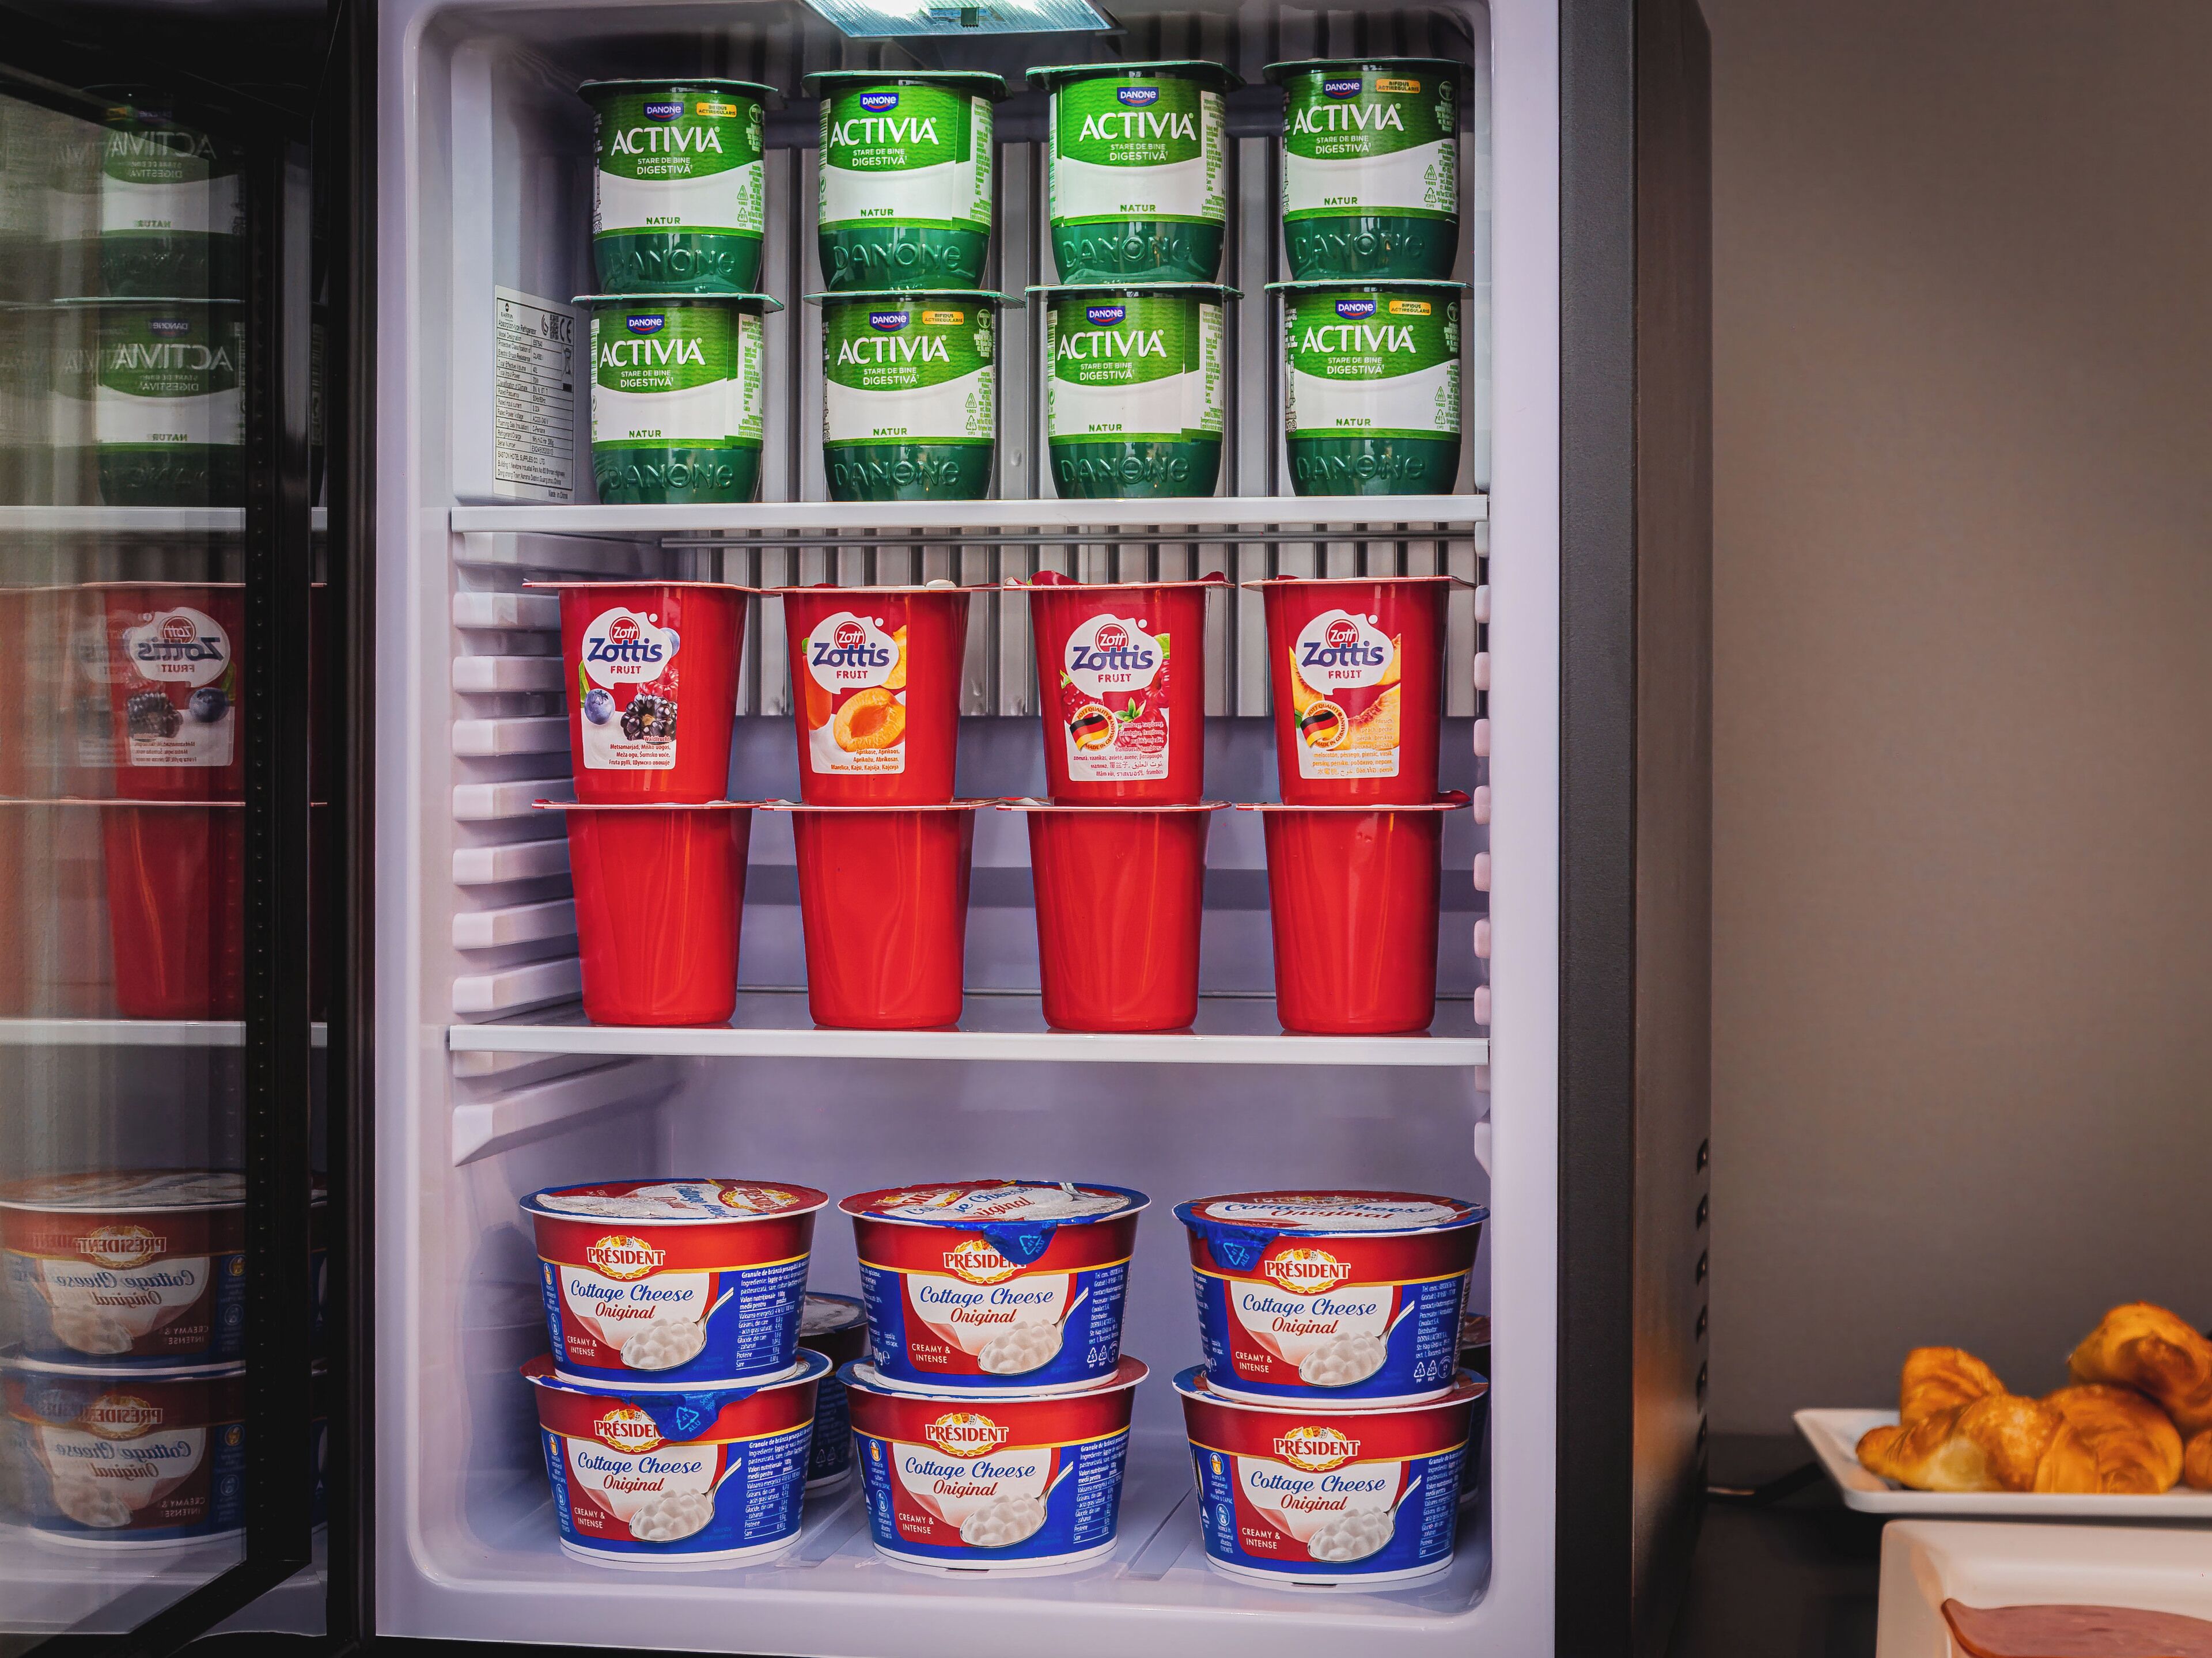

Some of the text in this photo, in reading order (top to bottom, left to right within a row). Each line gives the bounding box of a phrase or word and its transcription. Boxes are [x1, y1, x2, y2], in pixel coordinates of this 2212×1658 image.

[1079, 112, 1196, 142] ACTIVIA
[1293, 104, 1404, 135] ACTIVIA
[830, 117, 939, 147] ACTIVIA
[611, 127, 722, 155] ACTIVIA
[1057, 330, 1167, 361] ACTIVIA
[1301, 325, 1416, 354] ACTIVIA
[600, 339, 706, 368] ACTIVIA
[837, 336, 950, 366] ACTIVIA
[873, 428, 907, 436] NATUR
[1089, 424, 1122, 432] NATUR
[613, 627, 638, 639] Zott
[839, 631, 863, 643] Zott
[1100, 633, 1126, 646] Zott
[1331, 629, 1357, 642] Zott
[587, 638, 662, 662] Zottis
[812, 643, 889, 666] Zottis
[1071, 645, 1153, 671] Zottis
[1301, 640, 1384, 667] Zottis
[611, 666, 641, 674] FRUIT
[836, 670, 868, 678] FRUIT
[1098, 674, 1131, 682] FRUIT
[1328, 670, 1362, 678] FRUIT
[1088, 707, 1109, 717] QUALITY
[589, 1247, 664, 1266] PRÉSIDENT
[945, 1252, 1025, 1270] PRÉSIDE
[1267, 1260, 1349, 1280] PRÉSIDENT
[571, 1280, 694, 1302] Cottage Cheese
[920, 1286, 1053, 1307] Cottage Cheese
[596, 1303, 654, 1320] Original
[1243, 1294, 1377, 1316] Cottage Cheese
[951, 1308, 1016, 1325] Original
[1272, 1318, 1337, 1335] Original
[567, 1336, 590, 1346] CREAMY
[912, 1343, 942, 1353] CREAMY
[571, 1346, 595, 1356] INTENSE
[916, 1353, 948, 1364] INTENSE
[1236, 1352, 1264, 1362] CREAMY
[1240, 1362, 1269, 1373] INTENSE
[596, 1421, 663, 1439] PRÉSIDEN
[688, 1420, 701, 1432] ALU
[927, 1425, 1007, 1444] PRÉSIDENT
[1275, 1439, 1358, 1458] PRÉSIDENT
[578, 1452, 702, 1474] Cottage Cheese
[905, 1456, 1036, 1479] Cottage Cheese
[603, 1475, 664, 1493] Original
[933, 1480, 998, 1497] Original
[1251, 1471, 1385, 1493] Cottage Cheese
[1281, 1495, 1348, 1512] Original
[574, 1507, 597, 1519] CREAMY
[899, 1513, 926, 1524] CREAMY
[578, 1517, 603, 1529] INTENSE
[903, 1523, 931, 1534] INTENSE
[1242, 1528, 1273, 1539] CREAMY
[1246, 1538, 1277, 1549] INTENSE
